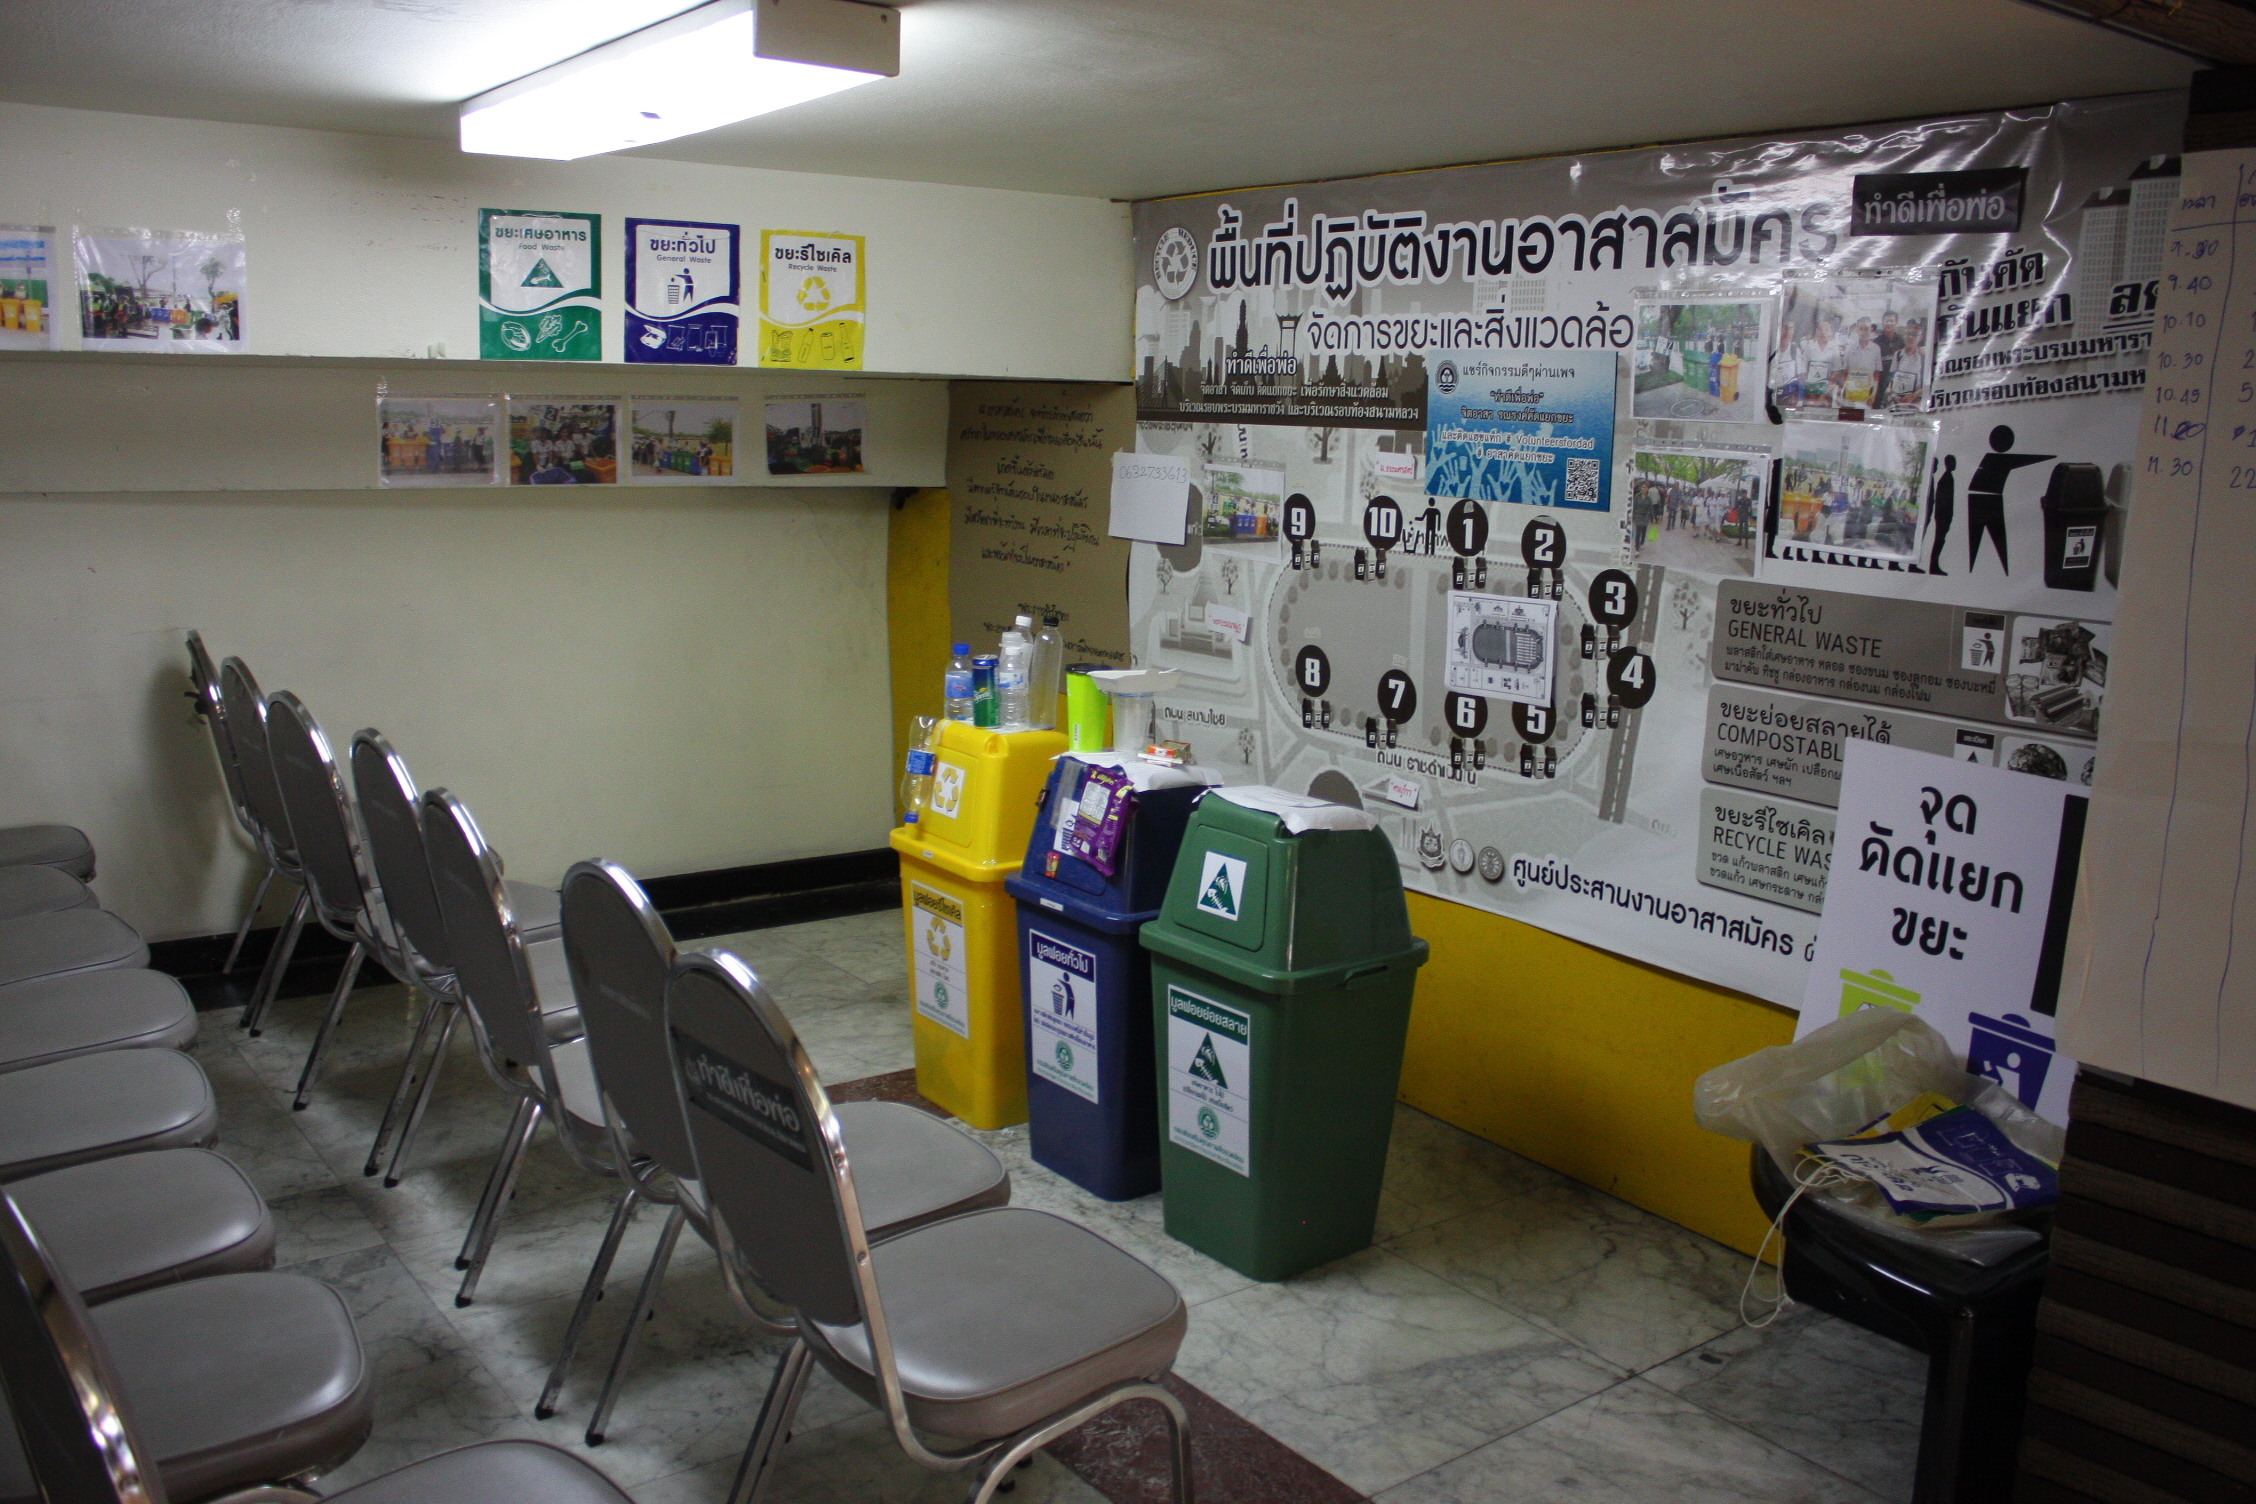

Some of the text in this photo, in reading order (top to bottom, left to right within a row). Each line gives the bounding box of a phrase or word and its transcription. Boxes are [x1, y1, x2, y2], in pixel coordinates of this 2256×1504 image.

[1864, 183, 2006, 225] ทำดีเพื่อพ่อ
[495, 227, 587, 241] ขยะเศษอาหาร
[518, 242, 566, 251] Food Waste
[650, 231, 716, 254] ขยะทั่วไป
[1210, 186, 1838, 300] พื้นที่ปฏิบัติงานอาสาสมัคร
[656, 254, 712, 264] General Waste
[774, 244, 852, 264] ขยะรีไซเคิล
[788, 263, 838, 273] Recycle Waste
[1226, 344, 1297, 375] ทำดีเพื่อพ่อ
[1516, 435, 1594, 450] Volunteersfordad
[1291, 507, 1306, 536] 9
[1369, 506, 1397, 538] 10
[1462, 518, 1473, 550] 1
[1534, 528, 1555, 562] 2
[1604, 581, 1627, 616] 3
[1730, 588, 1822, 625] ขยะทั่วไป
[1728, 619, 1883, 659] GENERAL WASTE
[1305, 657, 1321, 688] 8
[1620, 655, 1645, 689] 4
[1818, 657, 1845, 673] หลอด
[1388, 678, 1406, 709] 7
[1782, 669, 1835, 688] กล่องอาหาร
[1839, 678, 1881, 695] กล่องนม
[1456, 696, 1476, 729] 6
[1526, 705, 1547, 735] 5
[1720, 701, 1892, 745] ขยะย่อยสลายได้
[1377, 750, 1402, 767] ถนน
[1766, 756, 1799, 772] เศษผัก
[1772, 774, 1792, 787] ฯลฯ
[1715, 805, 1825, 845] ขยะรีไซเคิล
[1919, 786, 1977, 846] จุด
[1713, 825, 1788, 860] RECYCLE
[1858, 820, 2024, 914] คัดแยก
[1748, 877, 1805, 900] เศษกระดาษ
[1513, 857, 1795, 957] ศูนย์ประสานงานอาสาสมัคร
[1892, 907, 1968, 961] ขยะ
[1036, 941, 1089, 975] มูลฝอยทั่วไป
[1170, 995, 1248, 1037] มูลฝอยย่อยสลาย
[697, 1054, 800, 1132] ทำดีเพื่อพ่อ
